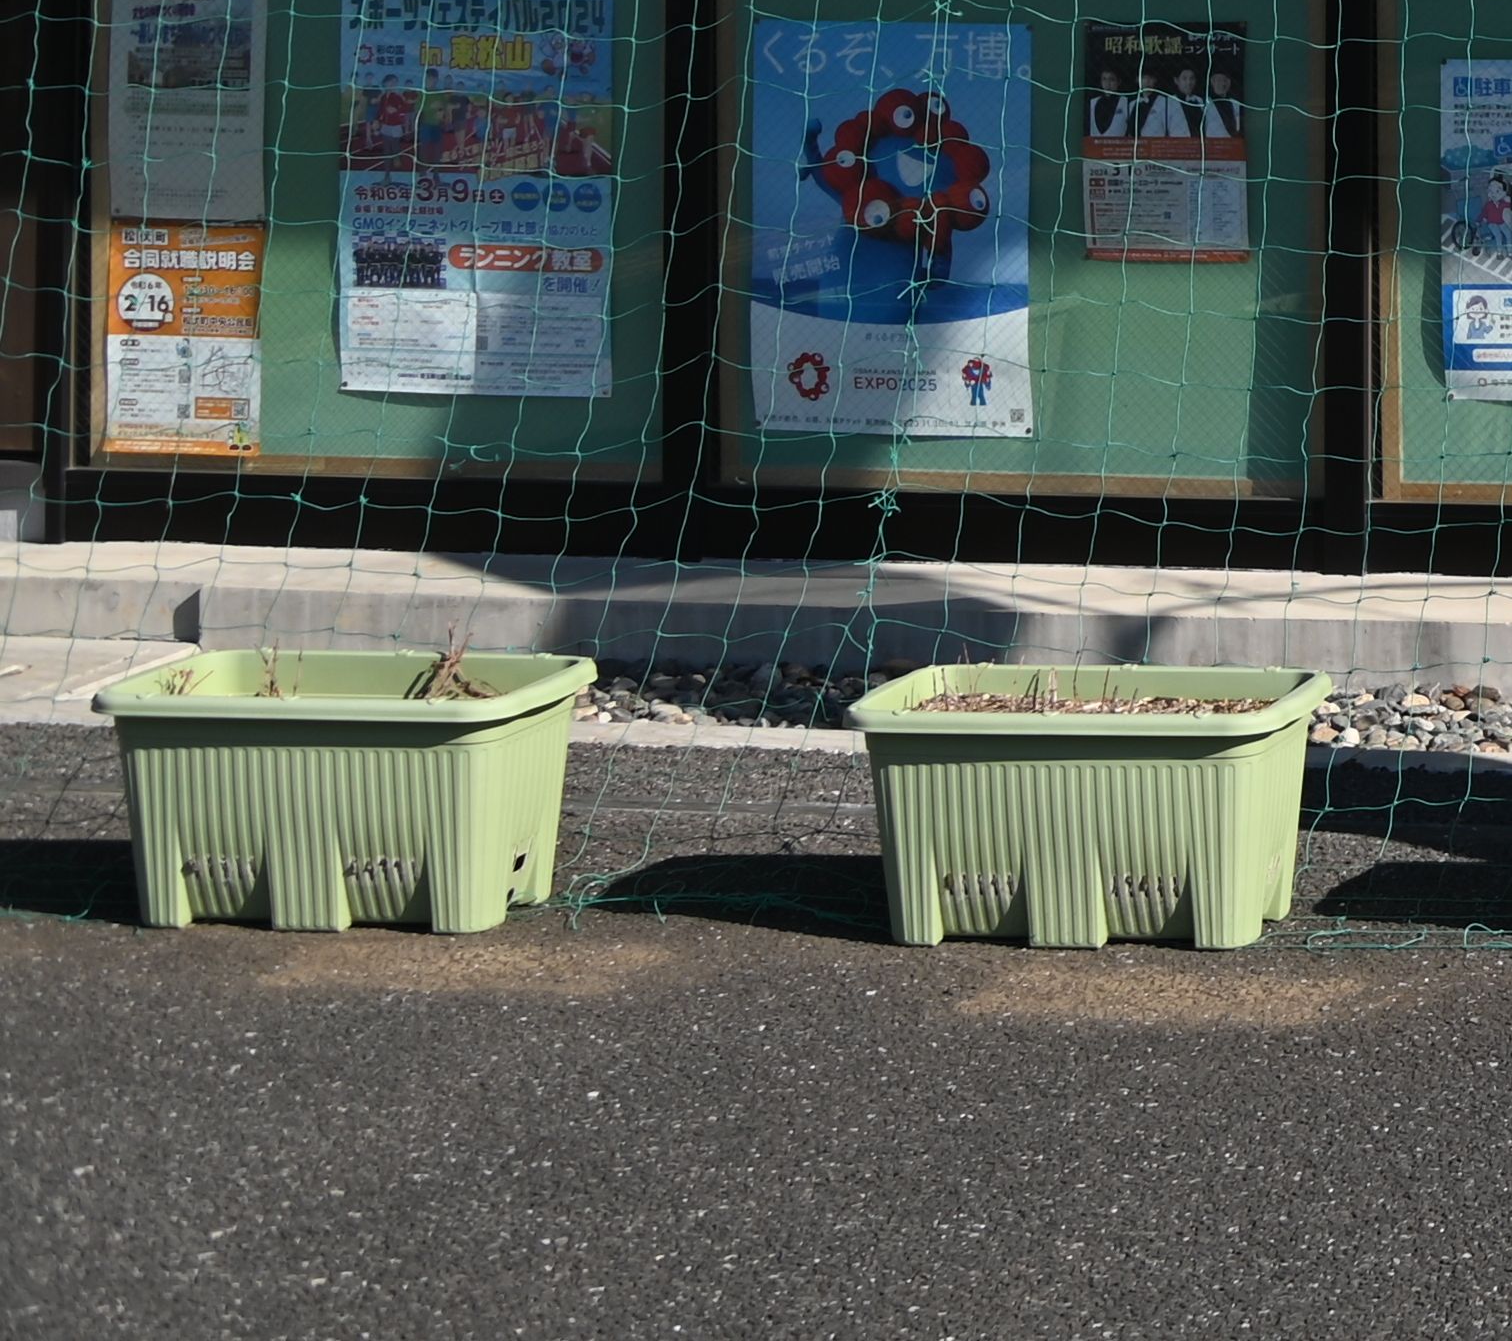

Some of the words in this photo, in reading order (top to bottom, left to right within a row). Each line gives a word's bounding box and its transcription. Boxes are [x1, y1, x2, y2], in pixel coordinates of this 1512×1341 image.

[419, 41, 443, 67] in
[450, 34, 533, 71] 東松山
[123, 248, 256, 271] 合同就職説明会
[459, 247, 593, 271] ランニング教室
